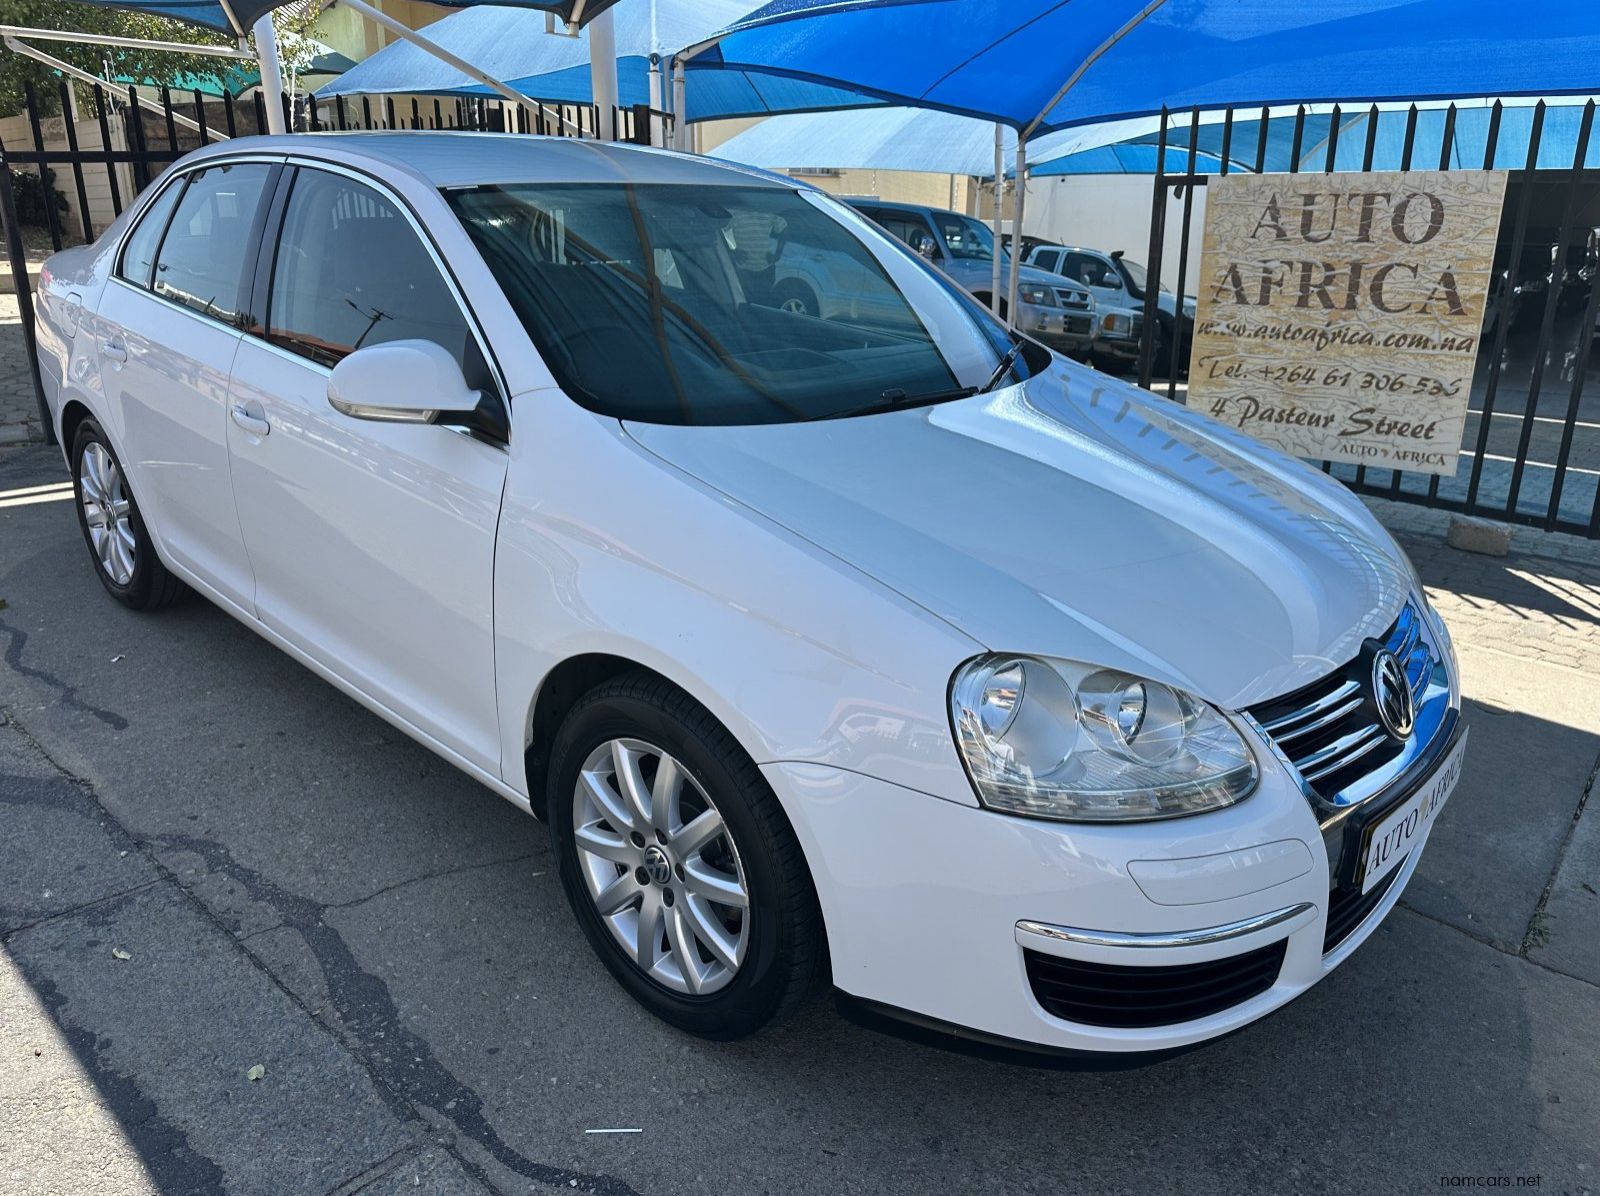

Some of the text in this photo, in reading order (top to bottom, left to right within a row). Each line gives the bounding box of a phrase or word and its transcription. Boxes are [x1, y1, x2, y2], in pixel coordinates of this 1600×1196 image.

[1250, 192, 1445, 245] AUTO
[1210, 259, 1469, 317] AFRICA
[1198, 355, 1248, 379] Tel.
[1259, 365, 1318, 385] +264
[1323, 368, 1352, 387] 61
[1360, 372, 1407, 392] 306
[1210, 395, 1437, 440] 4 Pasteur Street
[1340, 442, 1447, 467] AUTO AFRICA
[1366, 808, 1419, 878] AUTO
